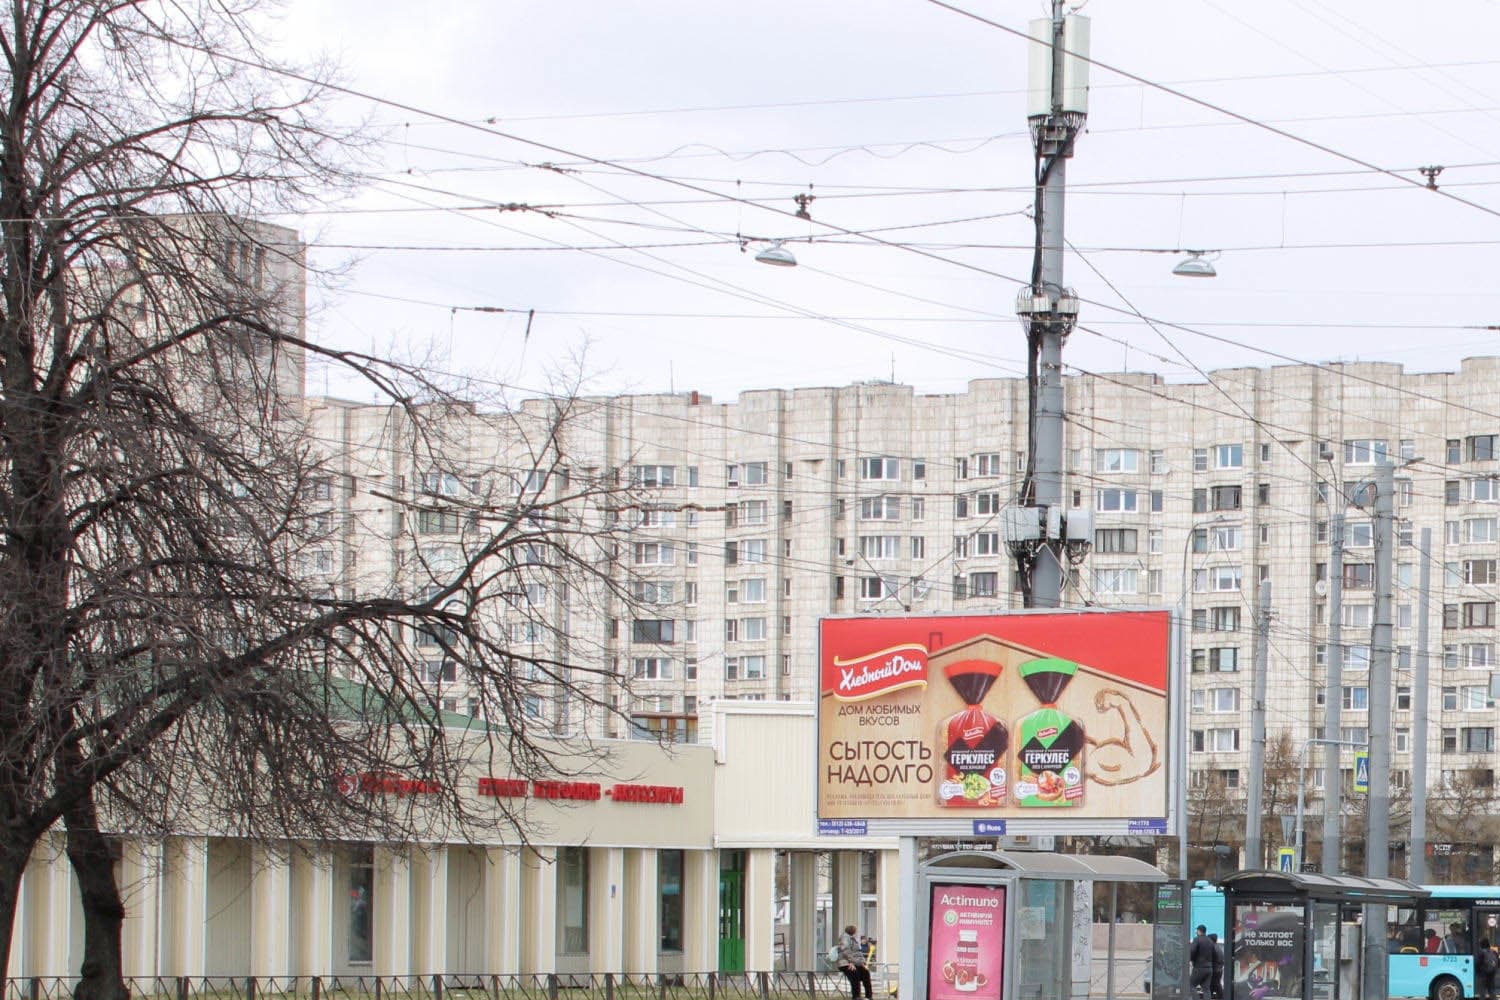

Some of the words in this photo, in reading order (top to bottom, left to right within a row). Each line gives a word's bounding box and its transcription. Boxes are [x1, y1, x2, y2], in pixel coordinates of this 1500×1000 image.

[838, 704, 864, 717] ДОМ
[865, 704, 921, 716] ЛЮБИМЫХ
[858, 715, 900, 727] ВКУСОВ
[829, 740, 932, 761] СЫТОСТЬ
[951, 753, 995, 766] ГЕРКУЛЕС
[1025, 752, 1069, 764] ГЕРКУЛЕС
[827, 763, 933, 788] НАДОЛГО
[941, 894, 999, 908] Actimuno
